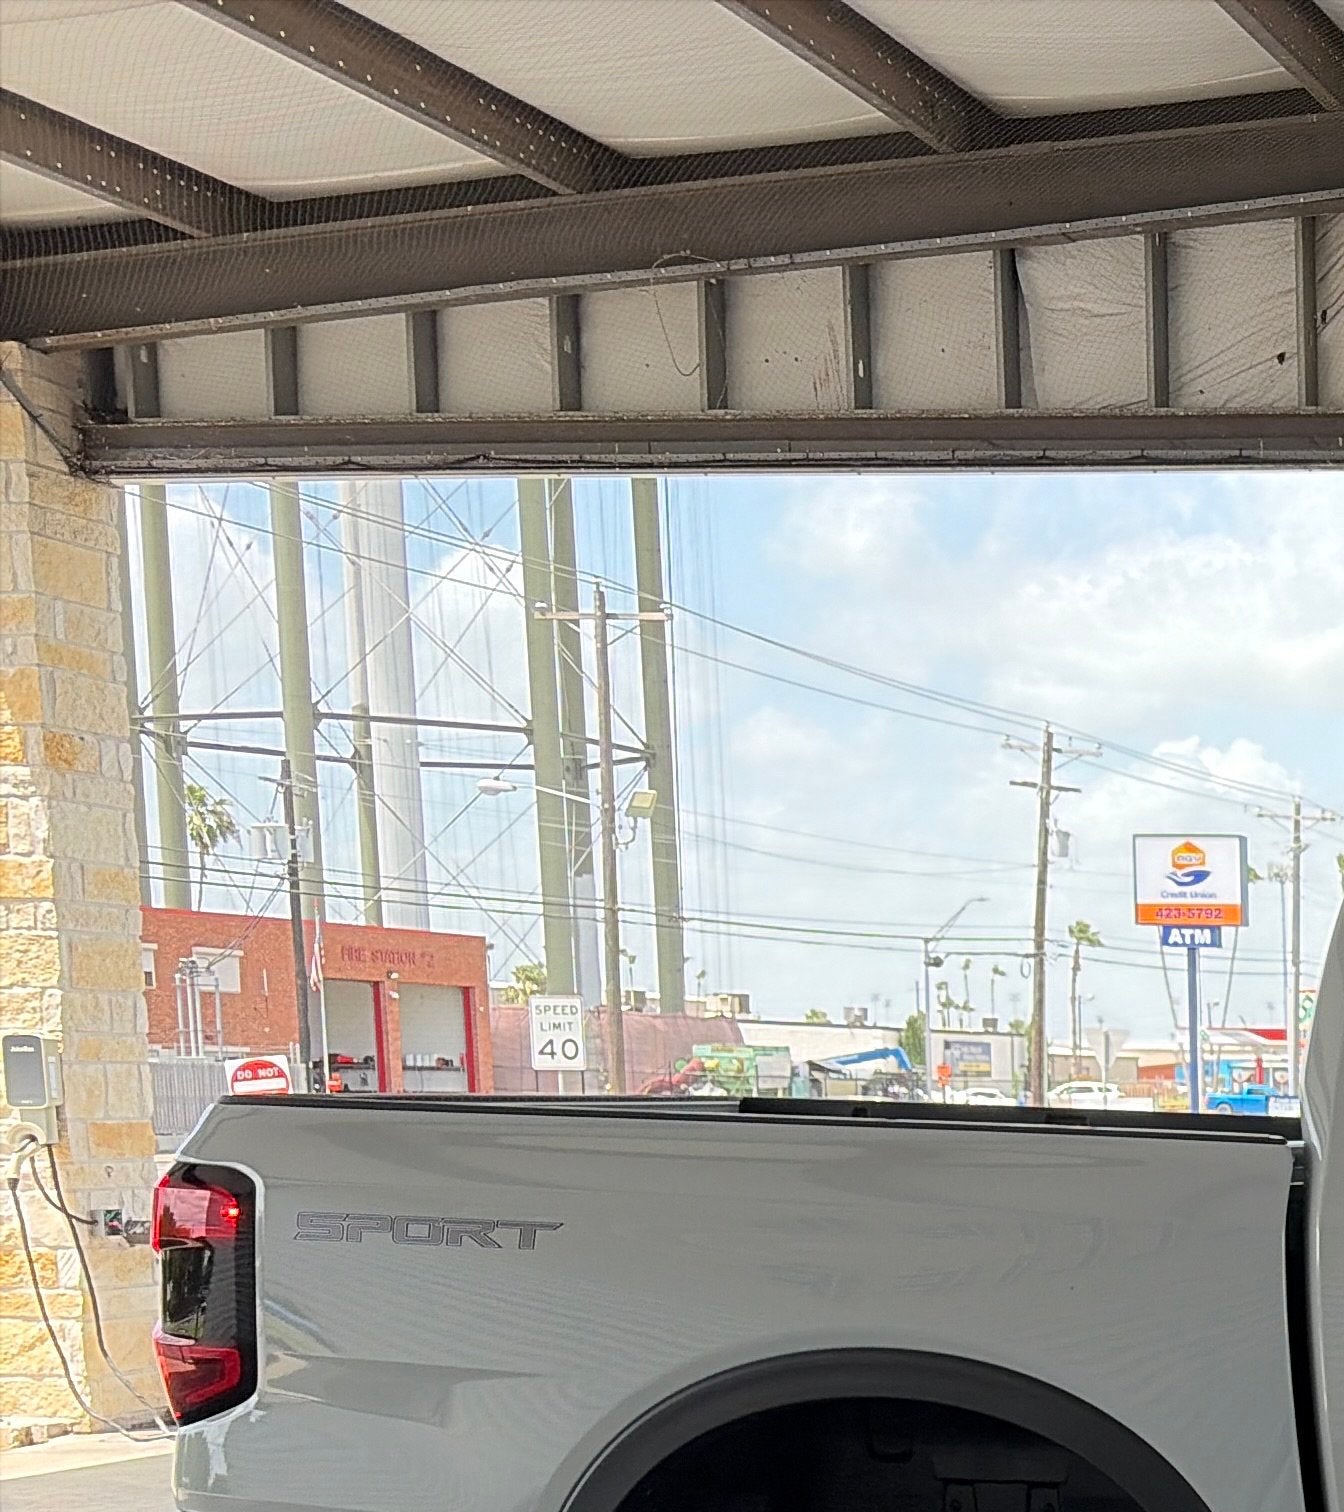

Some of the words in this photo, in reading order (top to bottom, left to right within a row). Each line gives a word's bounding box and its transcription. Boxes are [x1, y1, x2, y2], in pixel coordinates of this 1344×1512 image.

[1160, 890, 1188, 899] Credit
[1190, 890, 1217, 899] Union
[1168, 928, 1211, 944] ATM
[341, 946, 366, 962] FIRE
[370, 949, 416, 967] STATION
[535, 1005, 578, 1015] SPEED
[540, 1022, 573, 1032] LIMIT
[538, 1039, 579, 1060] 40
[237, 1069, 253, 1080] DO
[257, 1066, 279, 1078] NOT
[294, 1211, 564, 1249] SPORT
